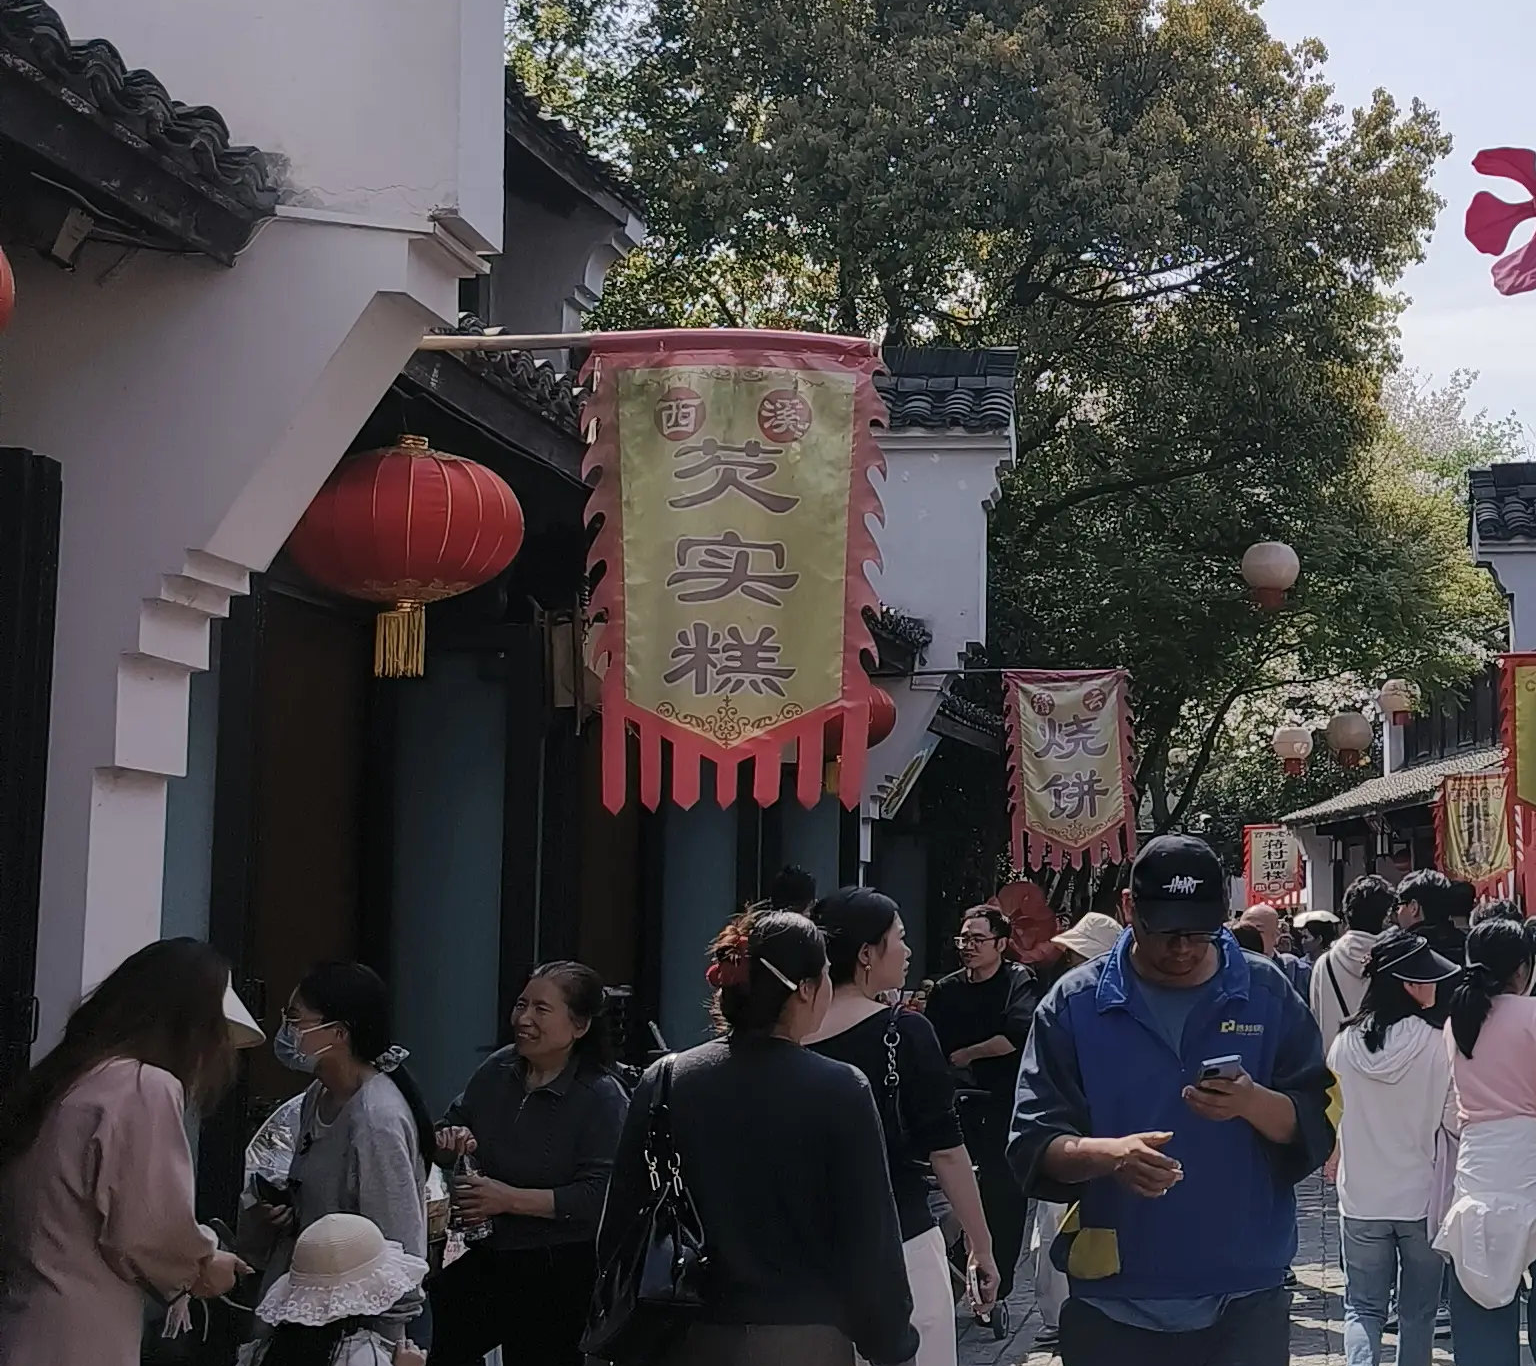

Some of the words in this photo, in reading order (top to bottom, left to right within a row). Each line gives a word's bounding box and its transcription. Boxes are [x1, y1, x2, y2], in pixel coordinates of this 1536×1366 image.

[663, 438, 800, 698] 芡实糕
[1033, 714, 1110, 820] 烧饼
[1262, 839, 1288, 881] 蒋村酒楼
